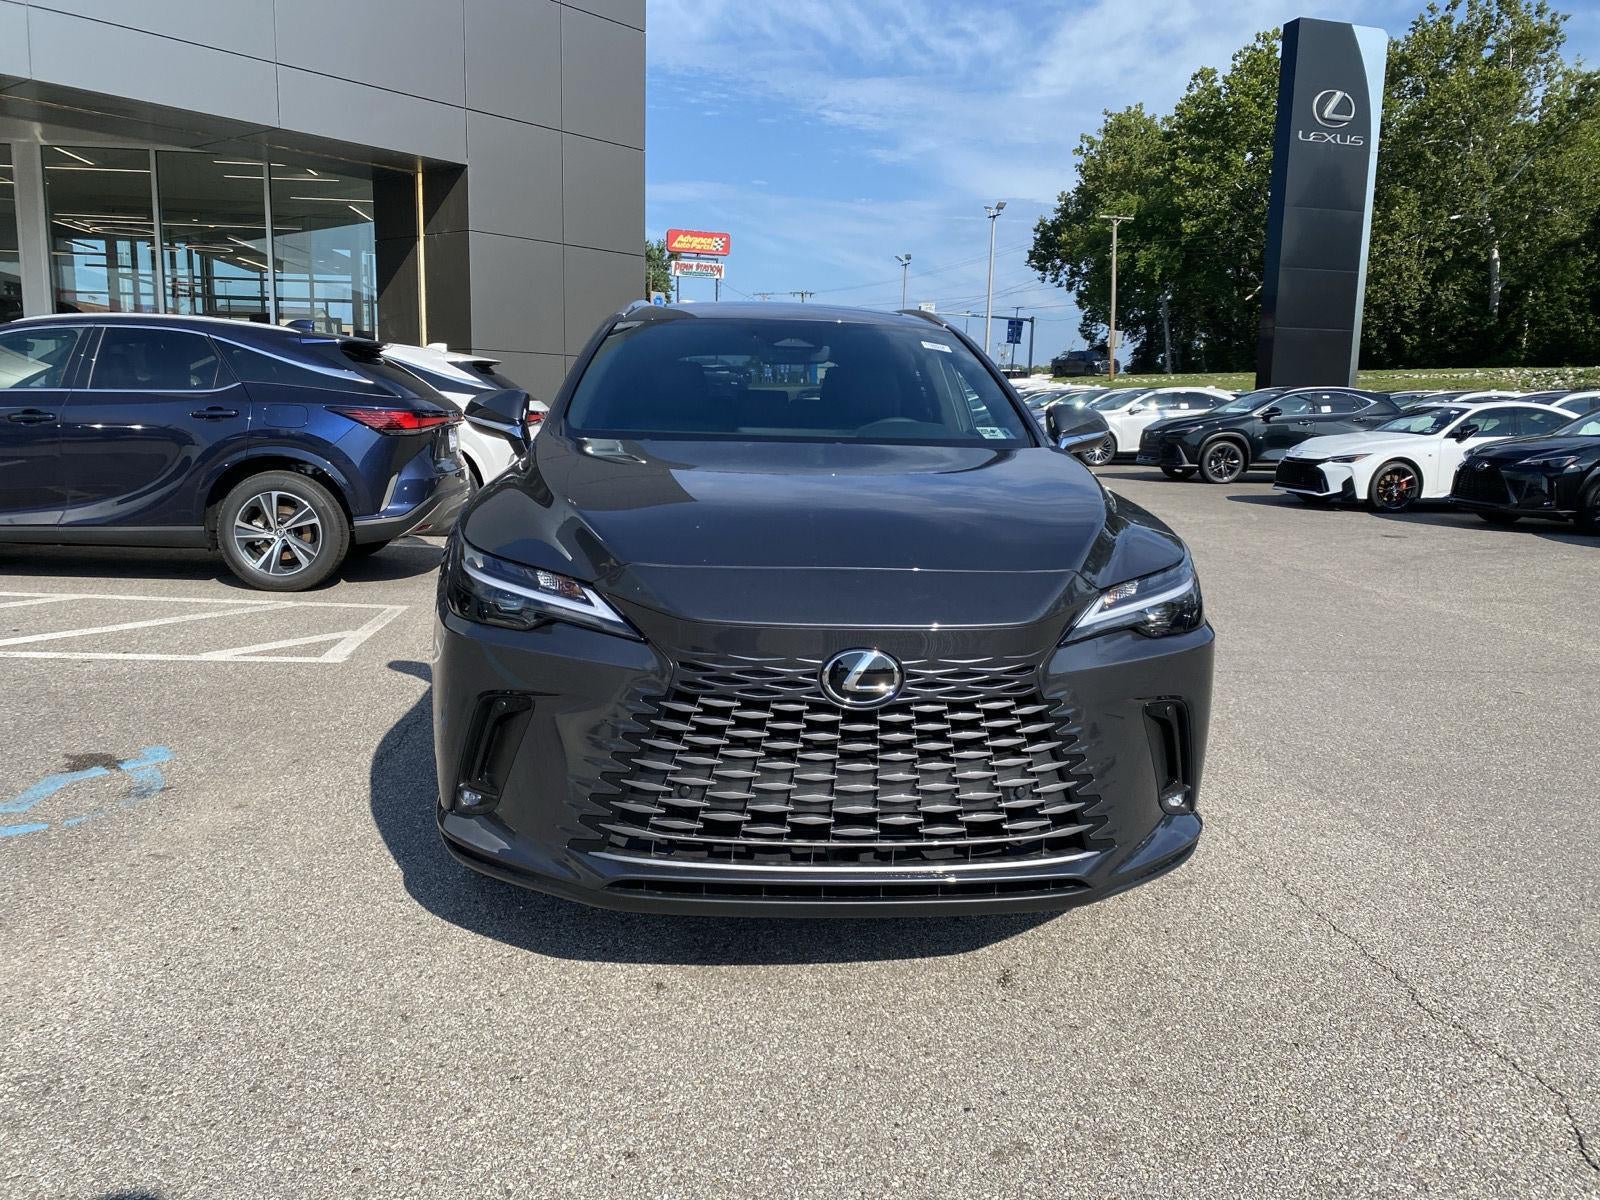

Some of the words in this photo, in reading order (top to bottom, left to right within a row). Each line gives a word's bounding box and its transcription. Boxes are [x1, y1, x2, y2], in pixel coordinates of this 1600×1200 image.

[1298, 130, 1364, 146] LEXUS
[676, 234, 713, 244] Advance
[671, 240, 691, 249] Auto
